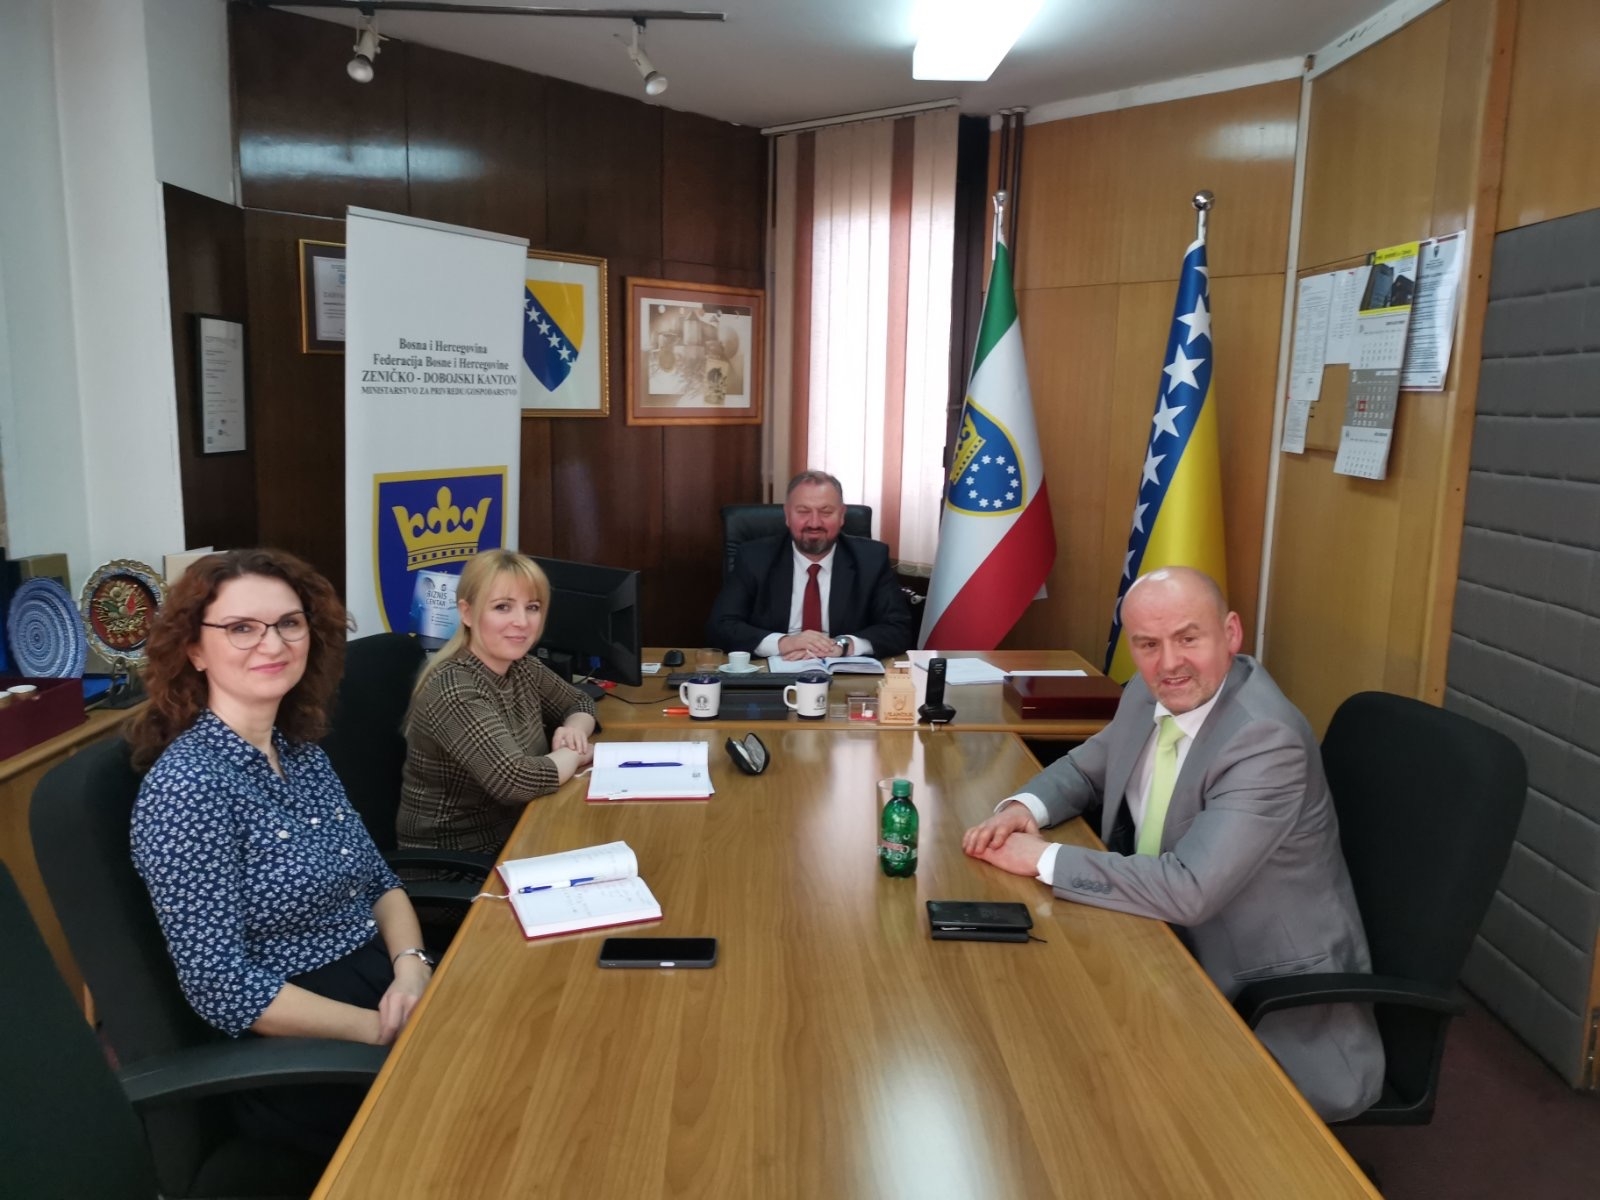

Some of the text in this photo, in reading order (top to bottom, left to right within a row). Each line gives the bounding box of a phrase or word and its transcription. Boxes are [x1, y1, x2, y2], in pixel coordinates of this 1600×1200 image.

[399, 338, 488, 355] Bosna i Hercegovina
[373, 353, 509, 372] Federacija Bosne i Hercegovine
[361, 368, 415, 383] ZENIČKO
[423, 372, 475, 384] DOBOJSKI
[477, 373, 518, 385] KANTON
[361, 386, 418, 395] MINISTARSTVO
[419, 387, 429, 395] ZA
